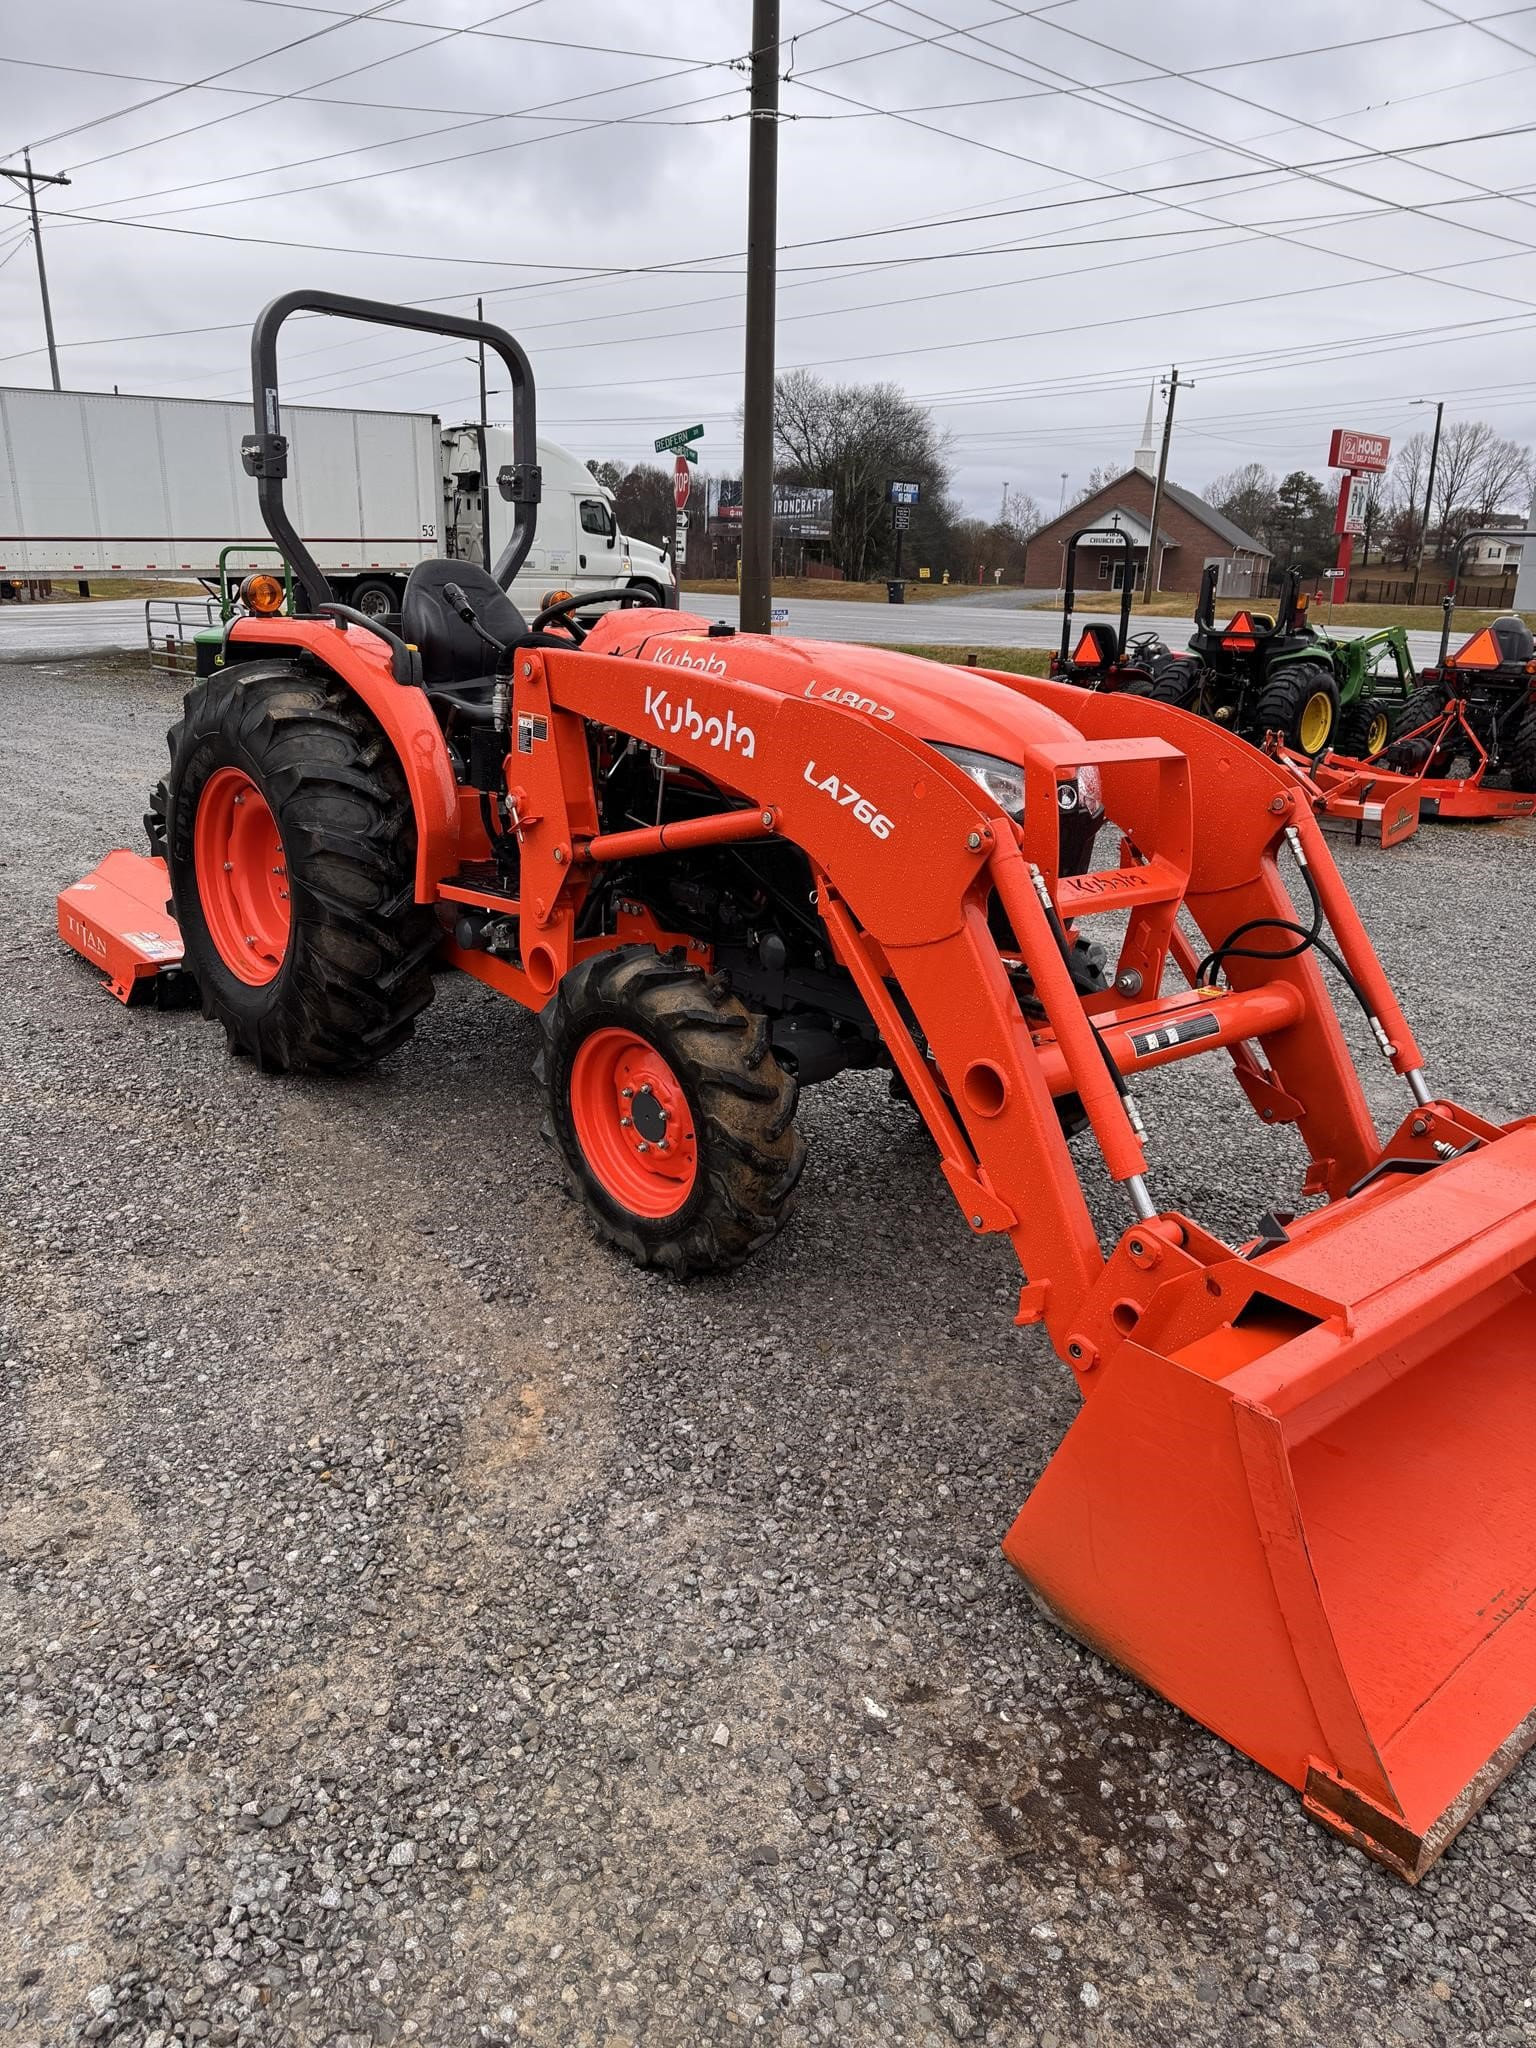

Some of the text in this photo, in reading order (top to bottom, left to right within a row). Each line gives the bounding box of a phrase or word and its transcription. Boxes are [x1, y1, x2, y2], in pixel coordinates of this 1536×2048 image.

[655, 431, 689, 451] REDFERN
[1345, 438, 1382, 460] 24 HOUR
[1356, 455, 1386, 466] SELF STORAGE
[892, 482, 919, 493] FIRST CHURCH
[653, 646, 727, 676] Kubota
[644, 685, 755, 759] Kubota
[803, 760, 896, 840] LA766
[67, 914, 107, 954] TITAN
